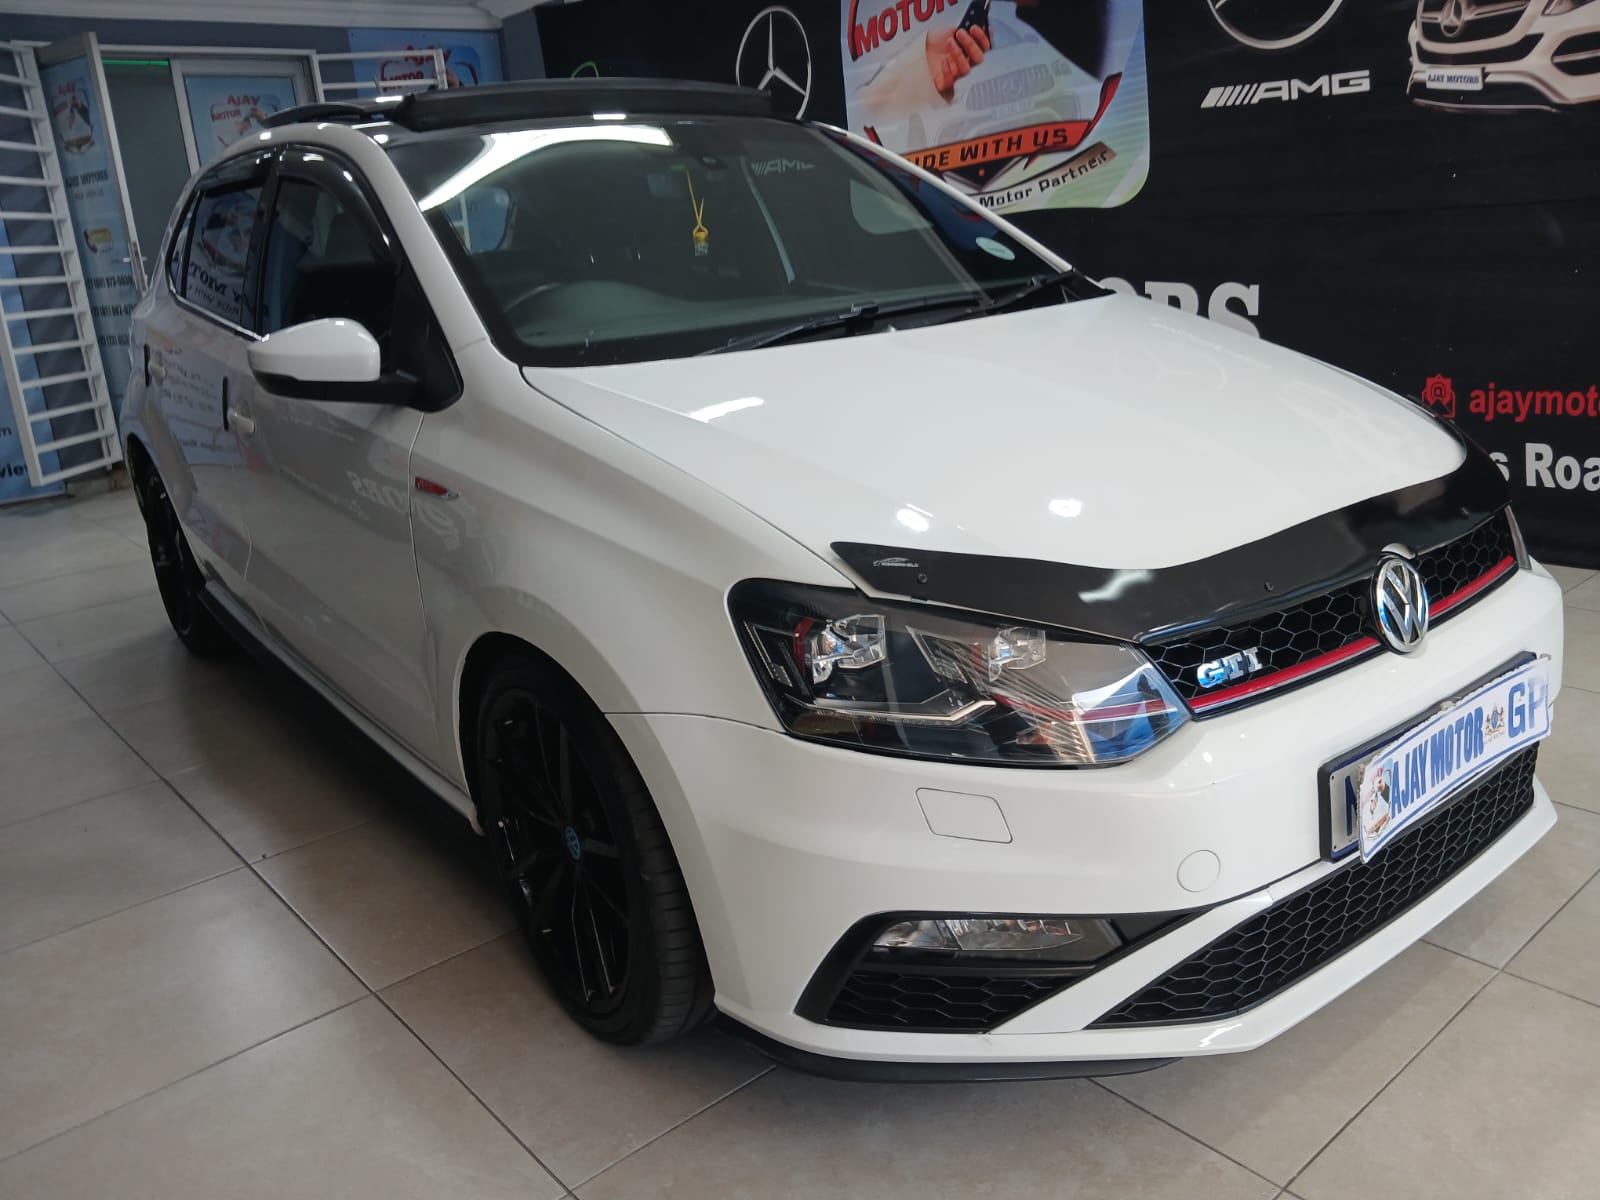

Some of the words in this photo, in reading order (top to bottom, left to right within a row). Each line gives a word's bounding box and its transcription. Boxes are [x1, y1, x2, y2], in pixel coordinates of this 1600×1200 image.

[226, 93, 260, 106] AJAY
[1427, 74, 1445, 83] AJAY
[1446, 74, 1480, 85] MOTORS
[906, 150, 950, 168] IDE
[960, 134, 1023, 162] WITH
[1032, 127, 1068, 147] US
[979, 187, 1032, 207] Motor
[1038, 149, 1108, 192] Partner
[1469, 382, 1600, 423] ajaymot
[1197, 646, 1263, 689] GTI
[1391, 737, 1428, 819] AJAY
[1430, 706, 1484, 788] MOTOR
